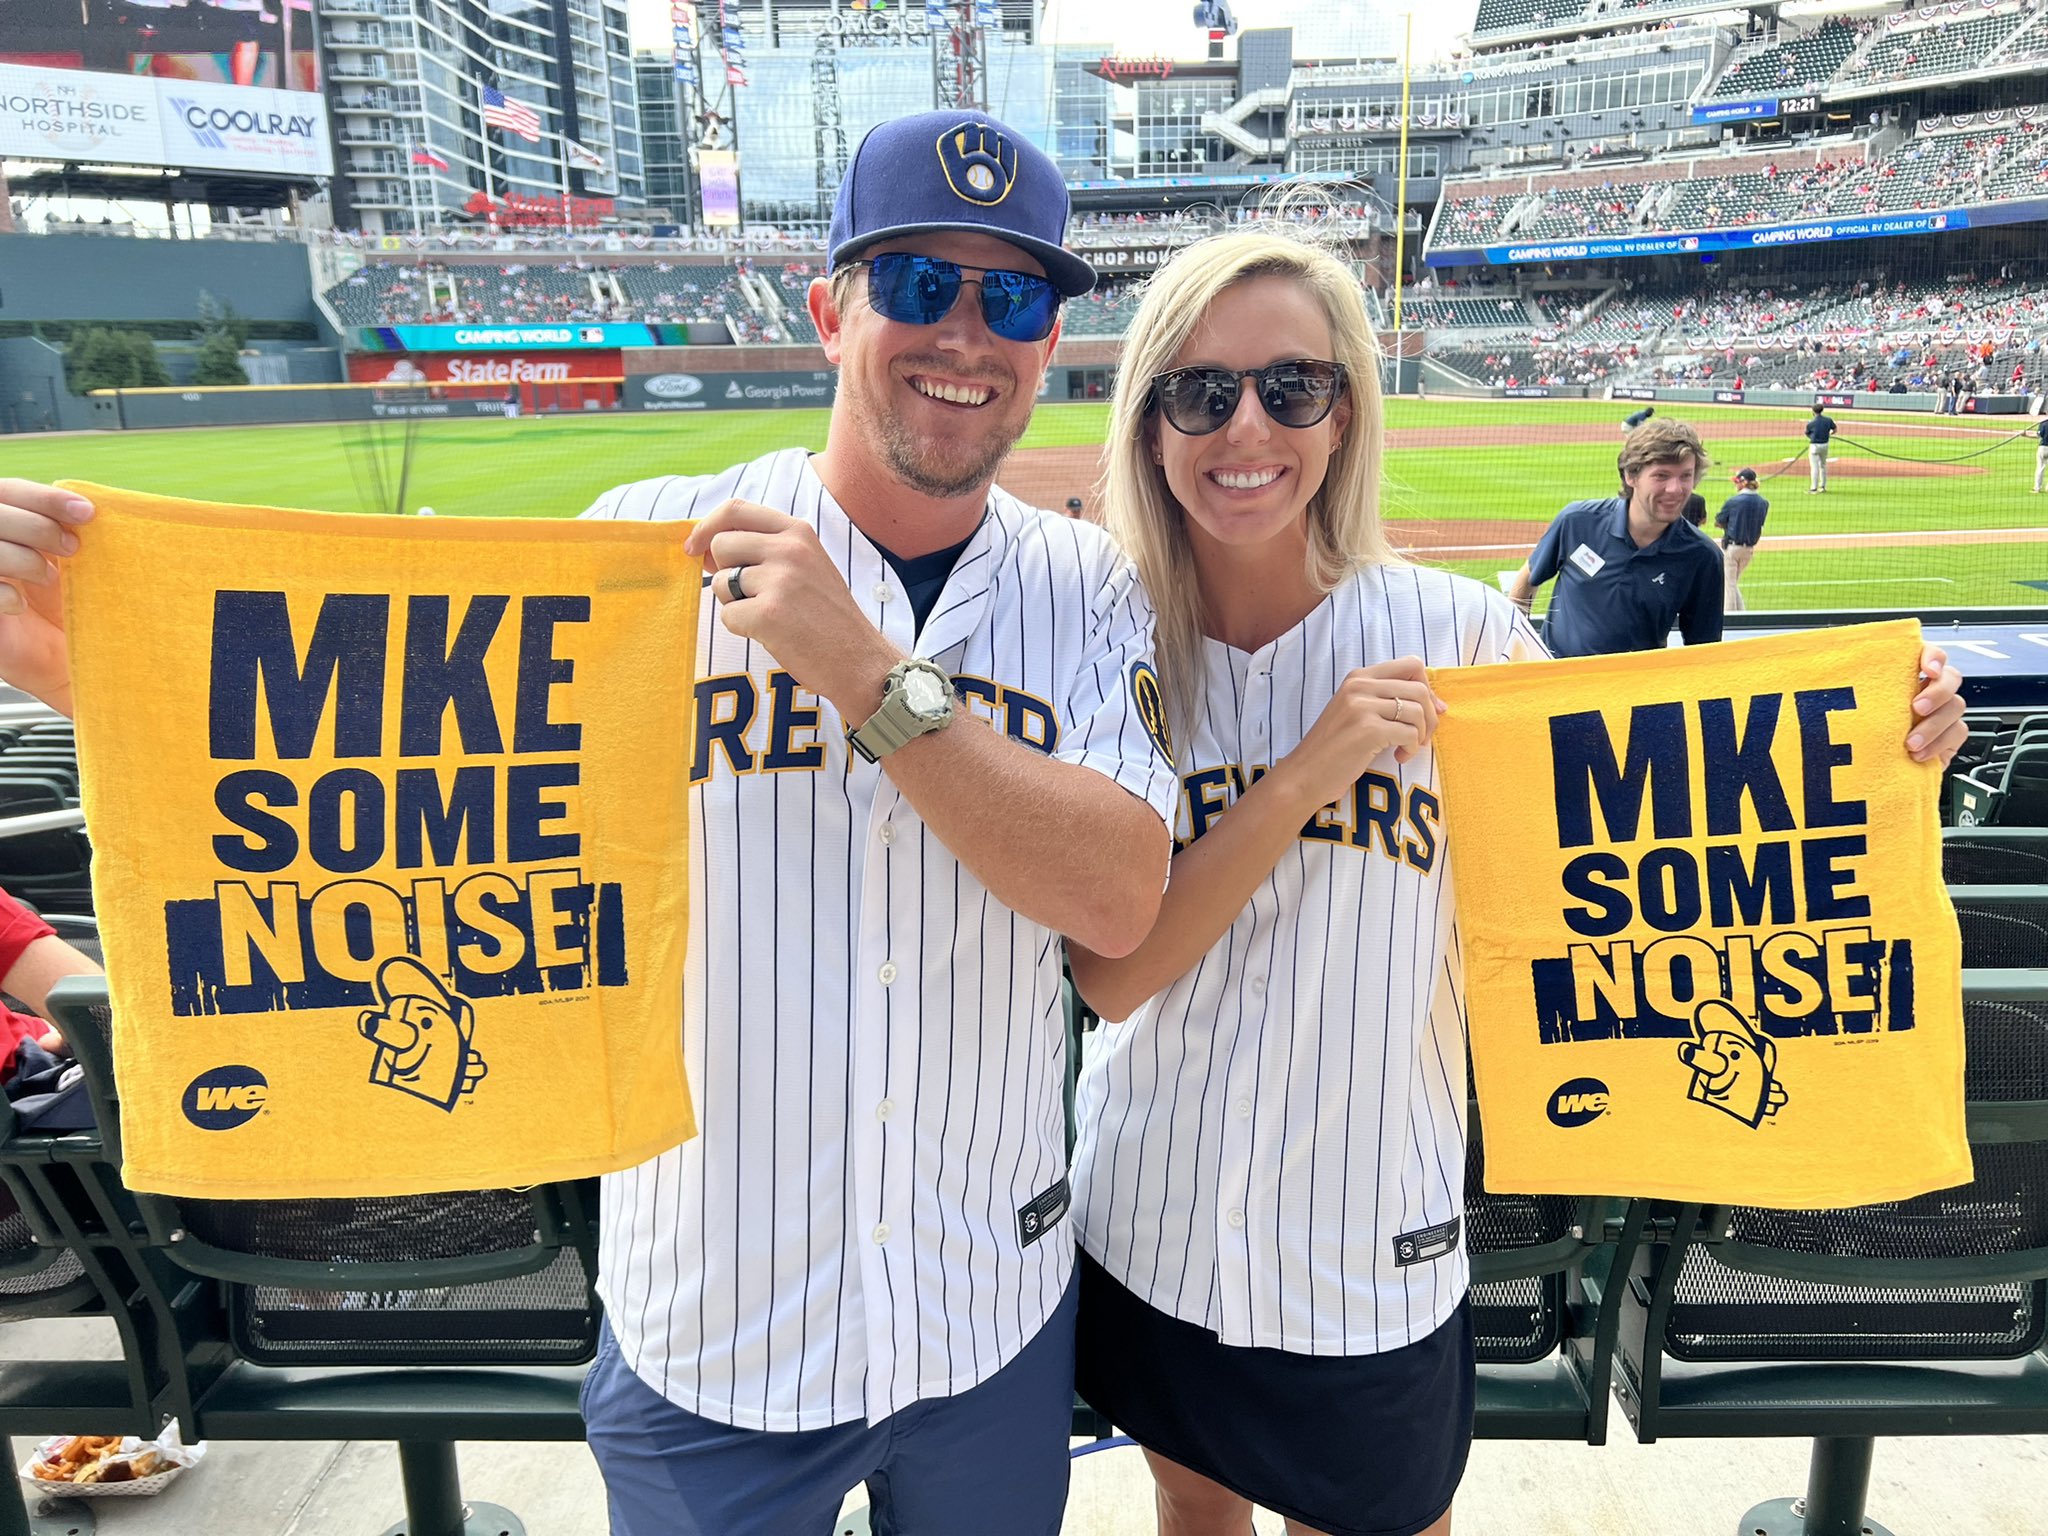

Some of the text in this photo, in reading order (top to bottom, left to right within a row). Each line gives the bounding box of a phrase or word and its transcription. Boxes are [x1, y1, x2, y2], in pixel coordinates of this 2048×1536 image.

[1782, 98, 1815, 112] 12:21
[22, 119, 122, 136] HOSPITAL
[186, 106, 315, 137] COOLRAY
[1752, 219, 1928, 244] CAMPING WORLD OFFICIAL RV DEALER OF
[1082, 252, 1128, 266] CHOP
[1508, 241, 1678, 260] CAMPING WORLD OFFICIAL RV DEALER OF
[455, 329, 573, 344] CAMPING WORLD
[655, 377, 690, 393] Ford
[745, 385, 826, 399] Georgia Power
[209, 589, 591, 760] MKE
[1548, 686, 1868, 849] MKE
[211, 762, 582, 873] SOME
[1561, 834, 1872, 938] SOME
[196, 1084, 270, 1111] we
[1557, 1092, 1609, 1114] we
